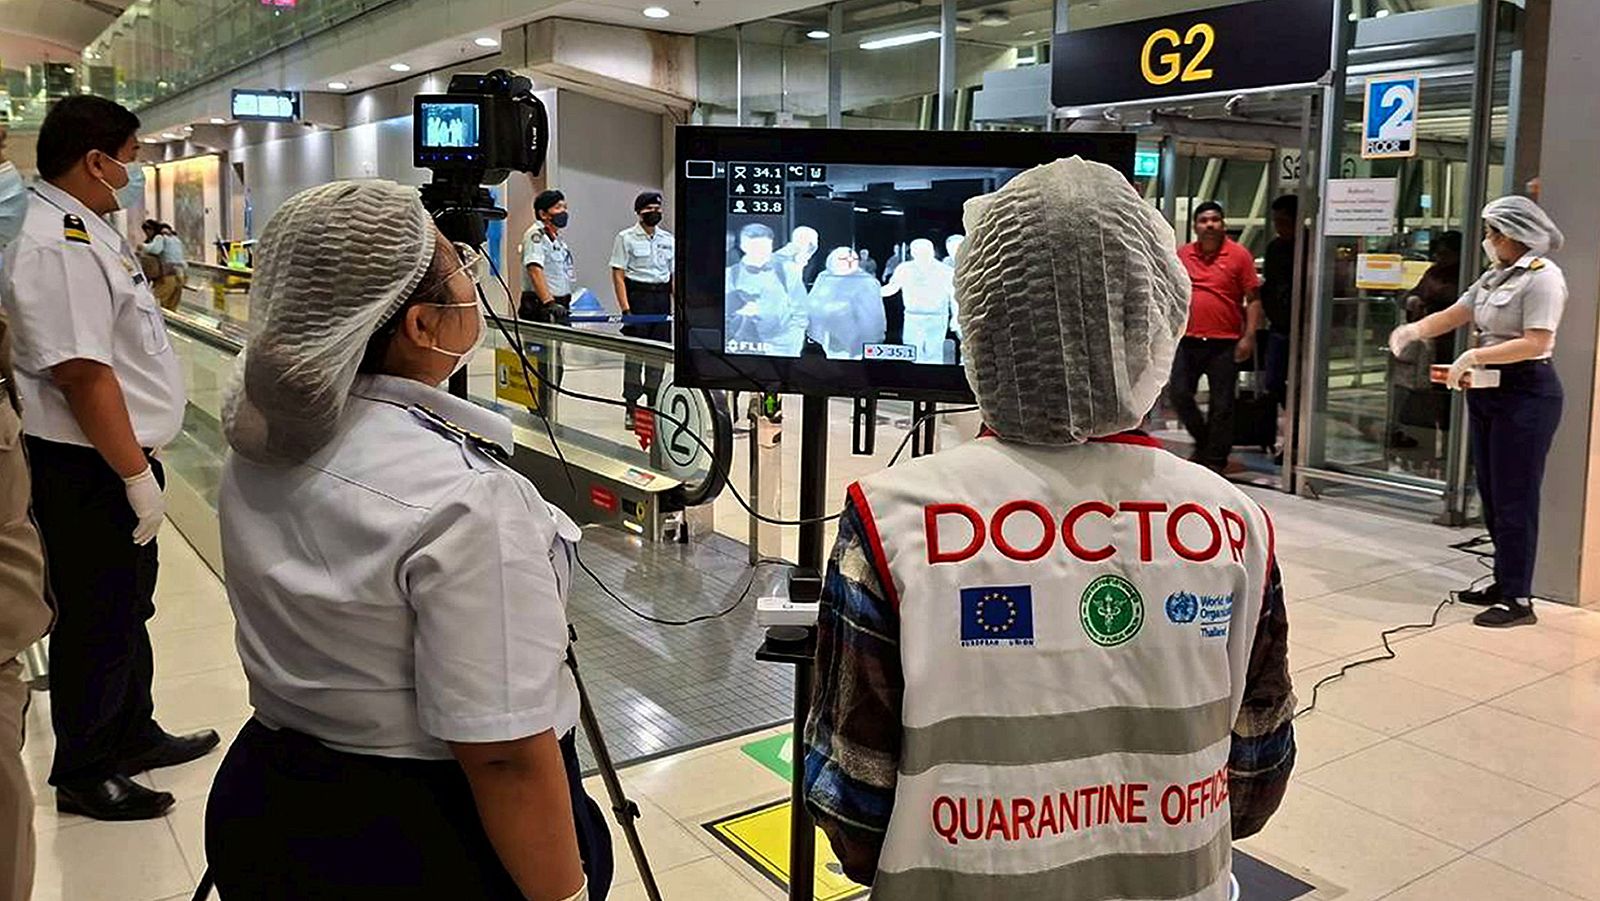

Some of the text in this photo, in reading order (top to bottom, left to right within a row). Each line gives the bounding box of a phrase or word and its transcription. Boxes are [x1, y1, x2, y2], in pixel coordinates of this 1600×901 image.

[1141, 23, 1215, 85] G2
[1379, 84, 1414, 140] 2
[752, 183, 782, 195] 35.1
[753, 167, 782, 179] 34.1
[752, 201, 783, 213] 33.8
[887, 347, 914, 358] 35.1
[671, 394, 690, 456] 2
[924, 500, 1248, 565] DOCTOR
[932, 784, 1149, 845] QUARANTINE
